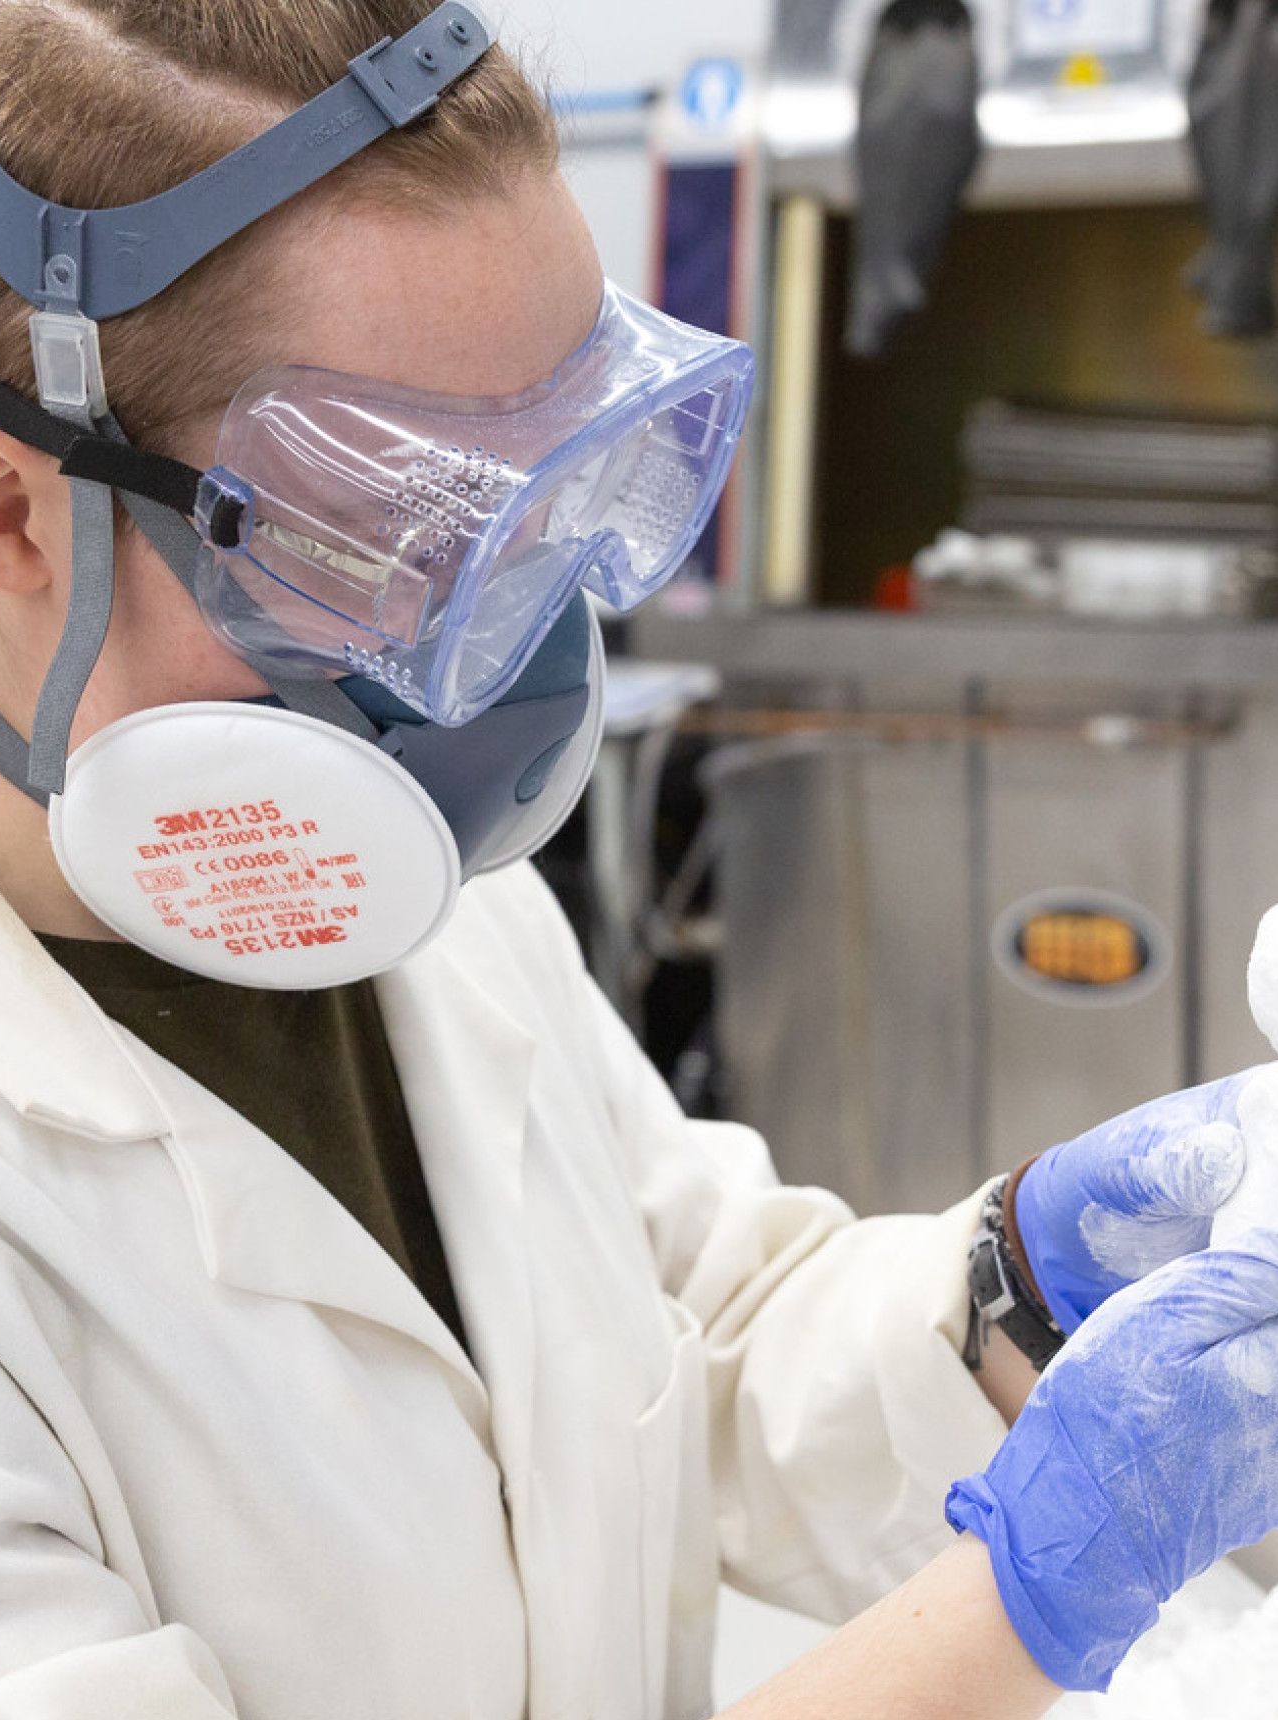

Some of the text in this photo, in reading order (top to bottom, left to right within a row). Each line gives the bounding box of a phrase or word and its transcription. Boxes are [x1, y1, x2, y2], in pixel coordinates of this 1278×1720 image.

[267, 824, 298, 840] P3
[224, 849, 289, 871] 0086
[272, 911, 316, 927] NZS
[331, 904, 358, 920] AS
[189, 926, 217, 939] P3
